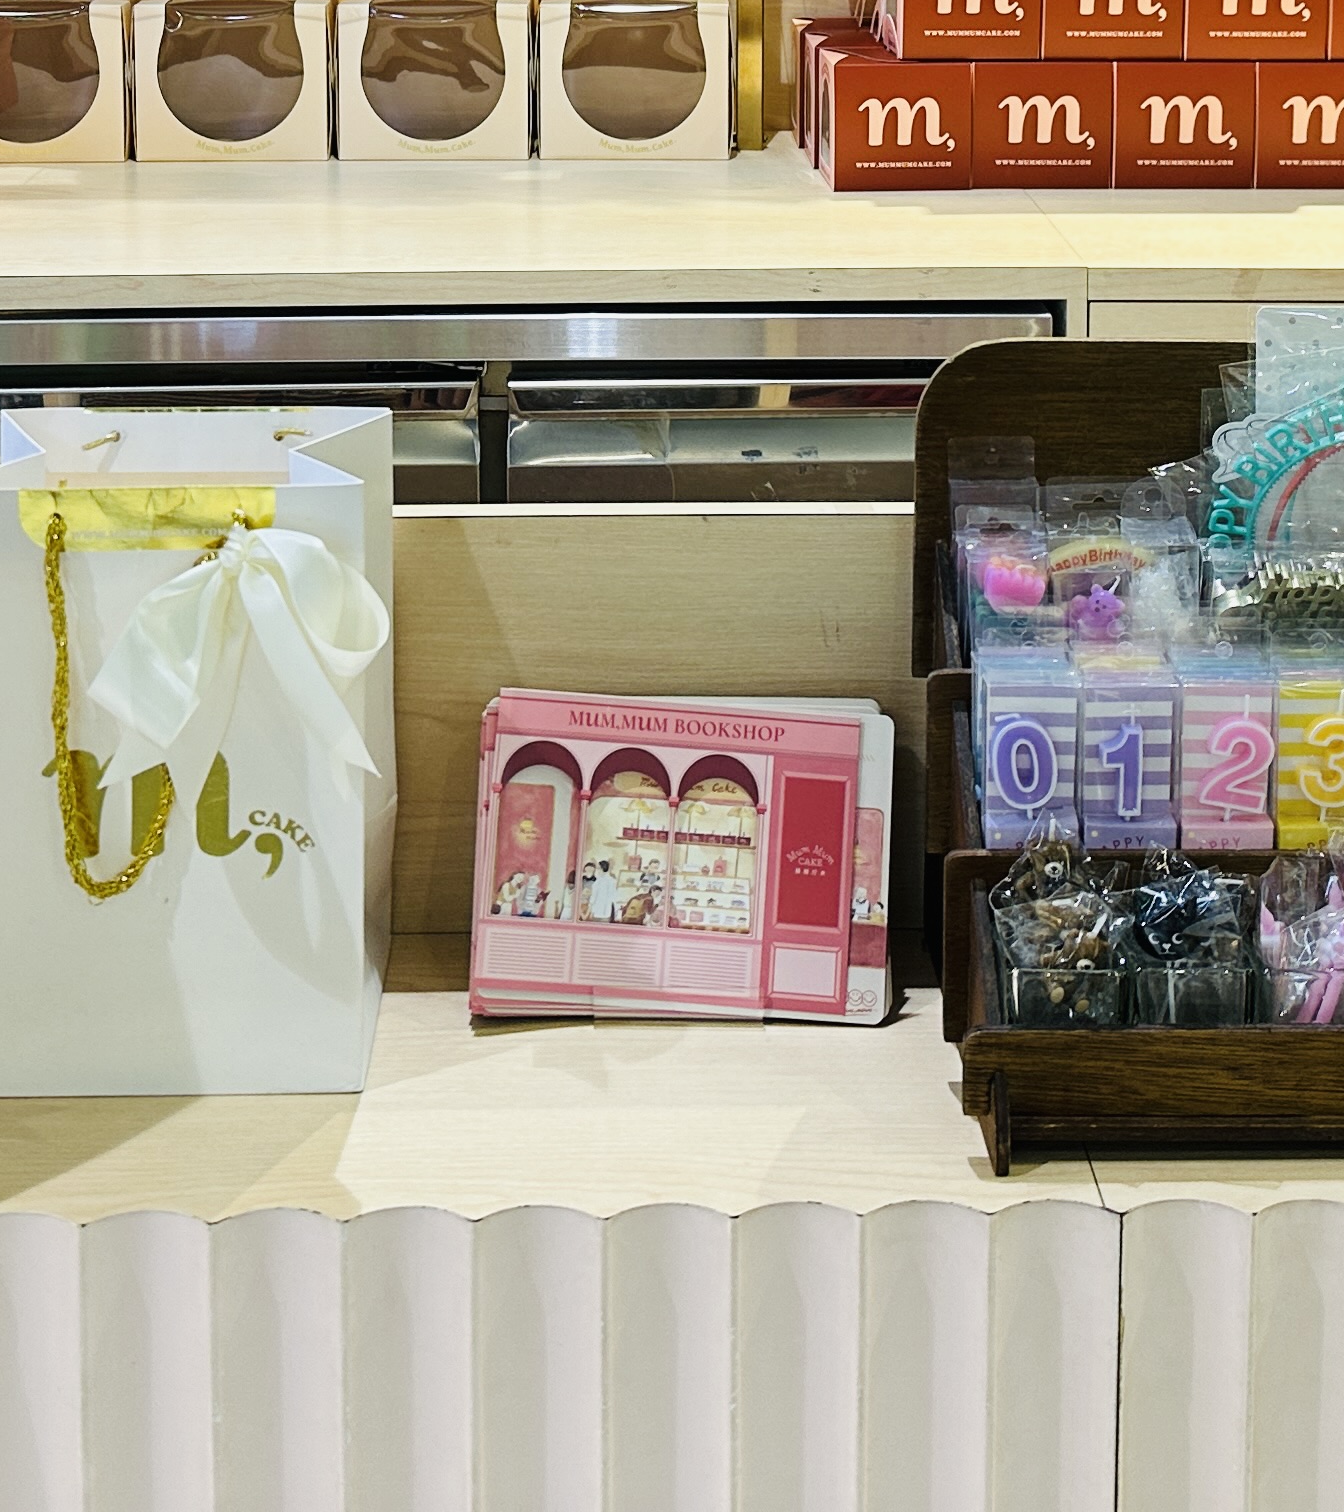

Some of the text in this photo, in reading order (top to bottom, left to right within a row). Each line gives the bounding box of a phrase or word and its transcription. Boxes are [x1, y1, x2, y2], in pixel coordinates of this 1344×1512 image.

[857, 96, 956, 152] m,
[997, 95, 1096, 151] m,
[1140, 95, 1238, 151] m,
[567, 709, 786, 743] MUM,MUM BOOKSHOP
[992, 714, 1058, 813] 0
[1100, 721, 1145, 818] 1
[1199, 716, 1276, 814] 2
[248, 808, 317, 854] CAKE
[786, 844, 836, 866] Mum Mum
[798, 857, 824, 867] CAKE
